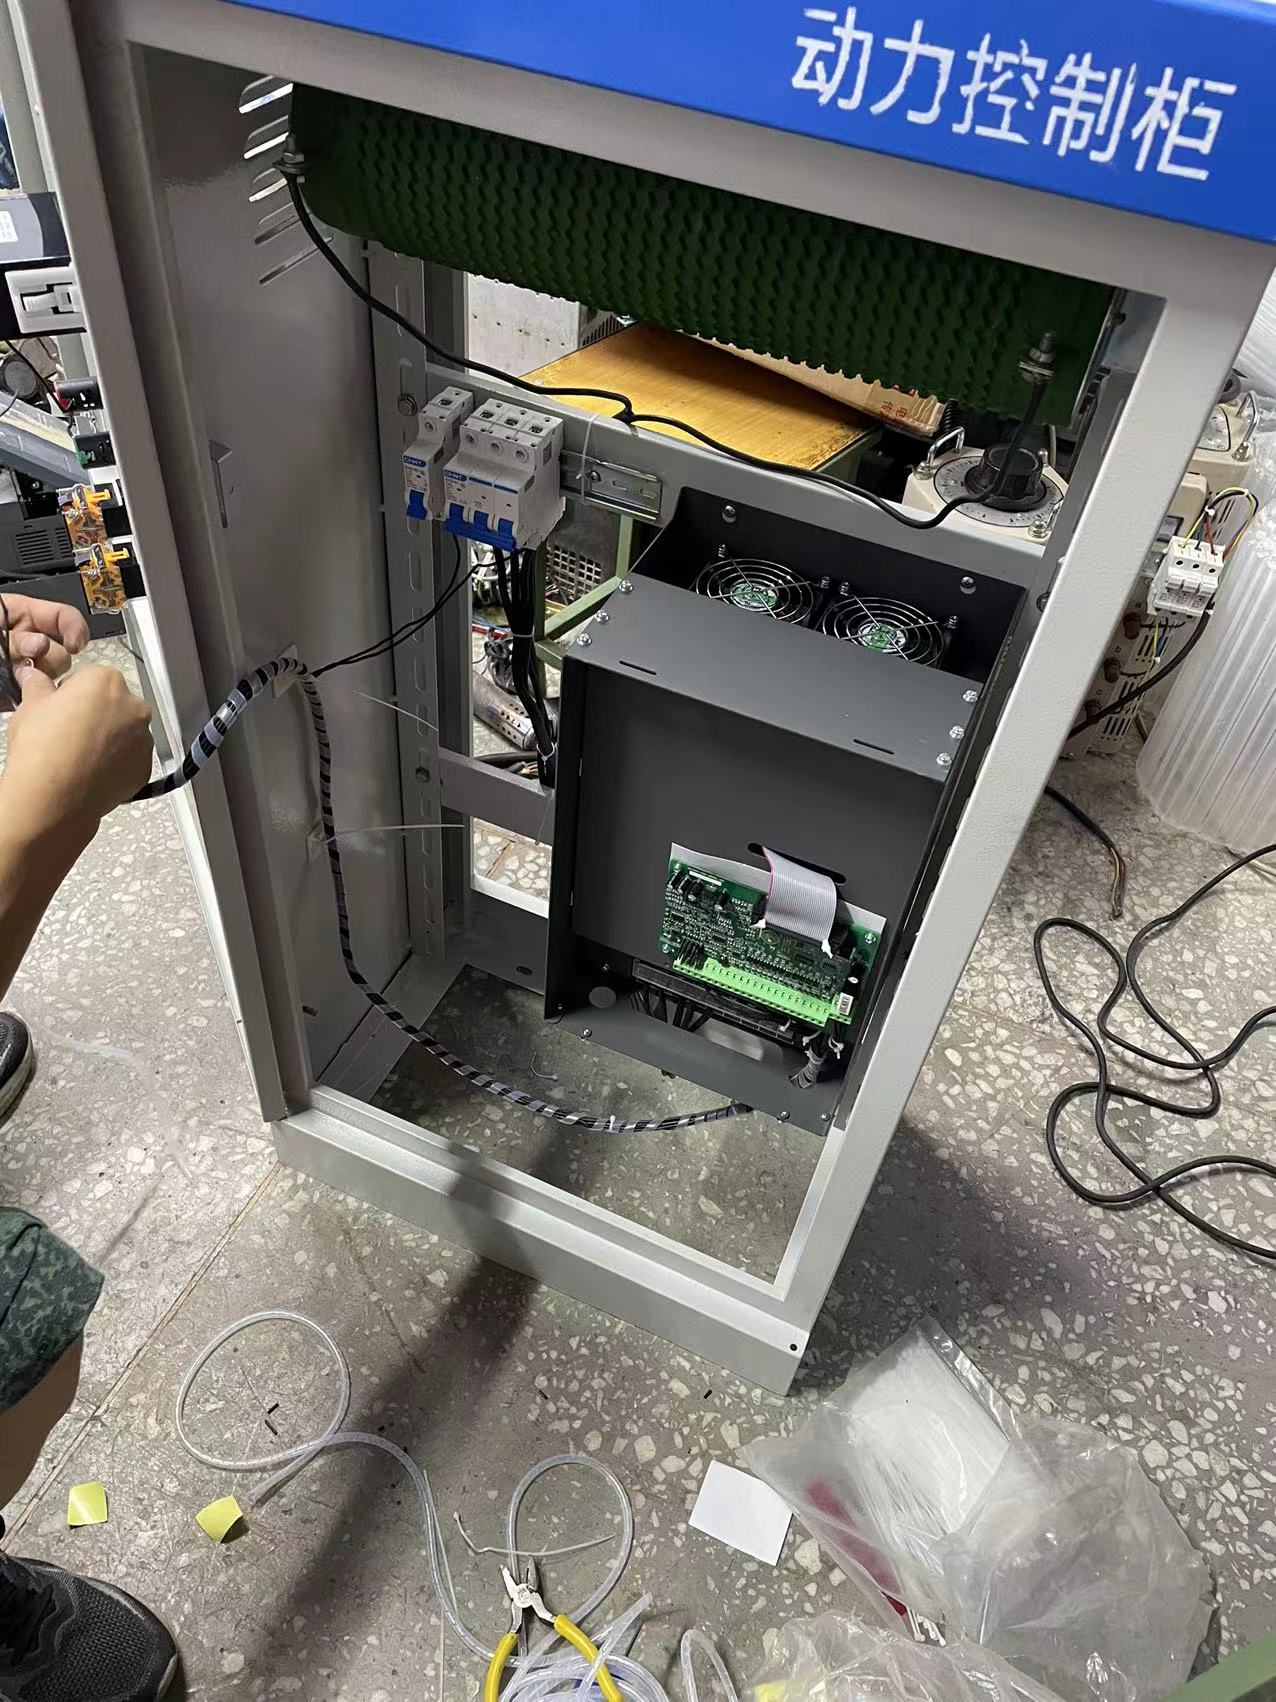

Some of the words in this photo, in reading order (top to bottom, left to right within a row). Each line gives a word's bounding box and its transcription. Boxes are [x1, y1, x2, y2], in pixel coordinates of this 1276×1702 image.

[790, 6, 1237, 182] 动力控制柜
